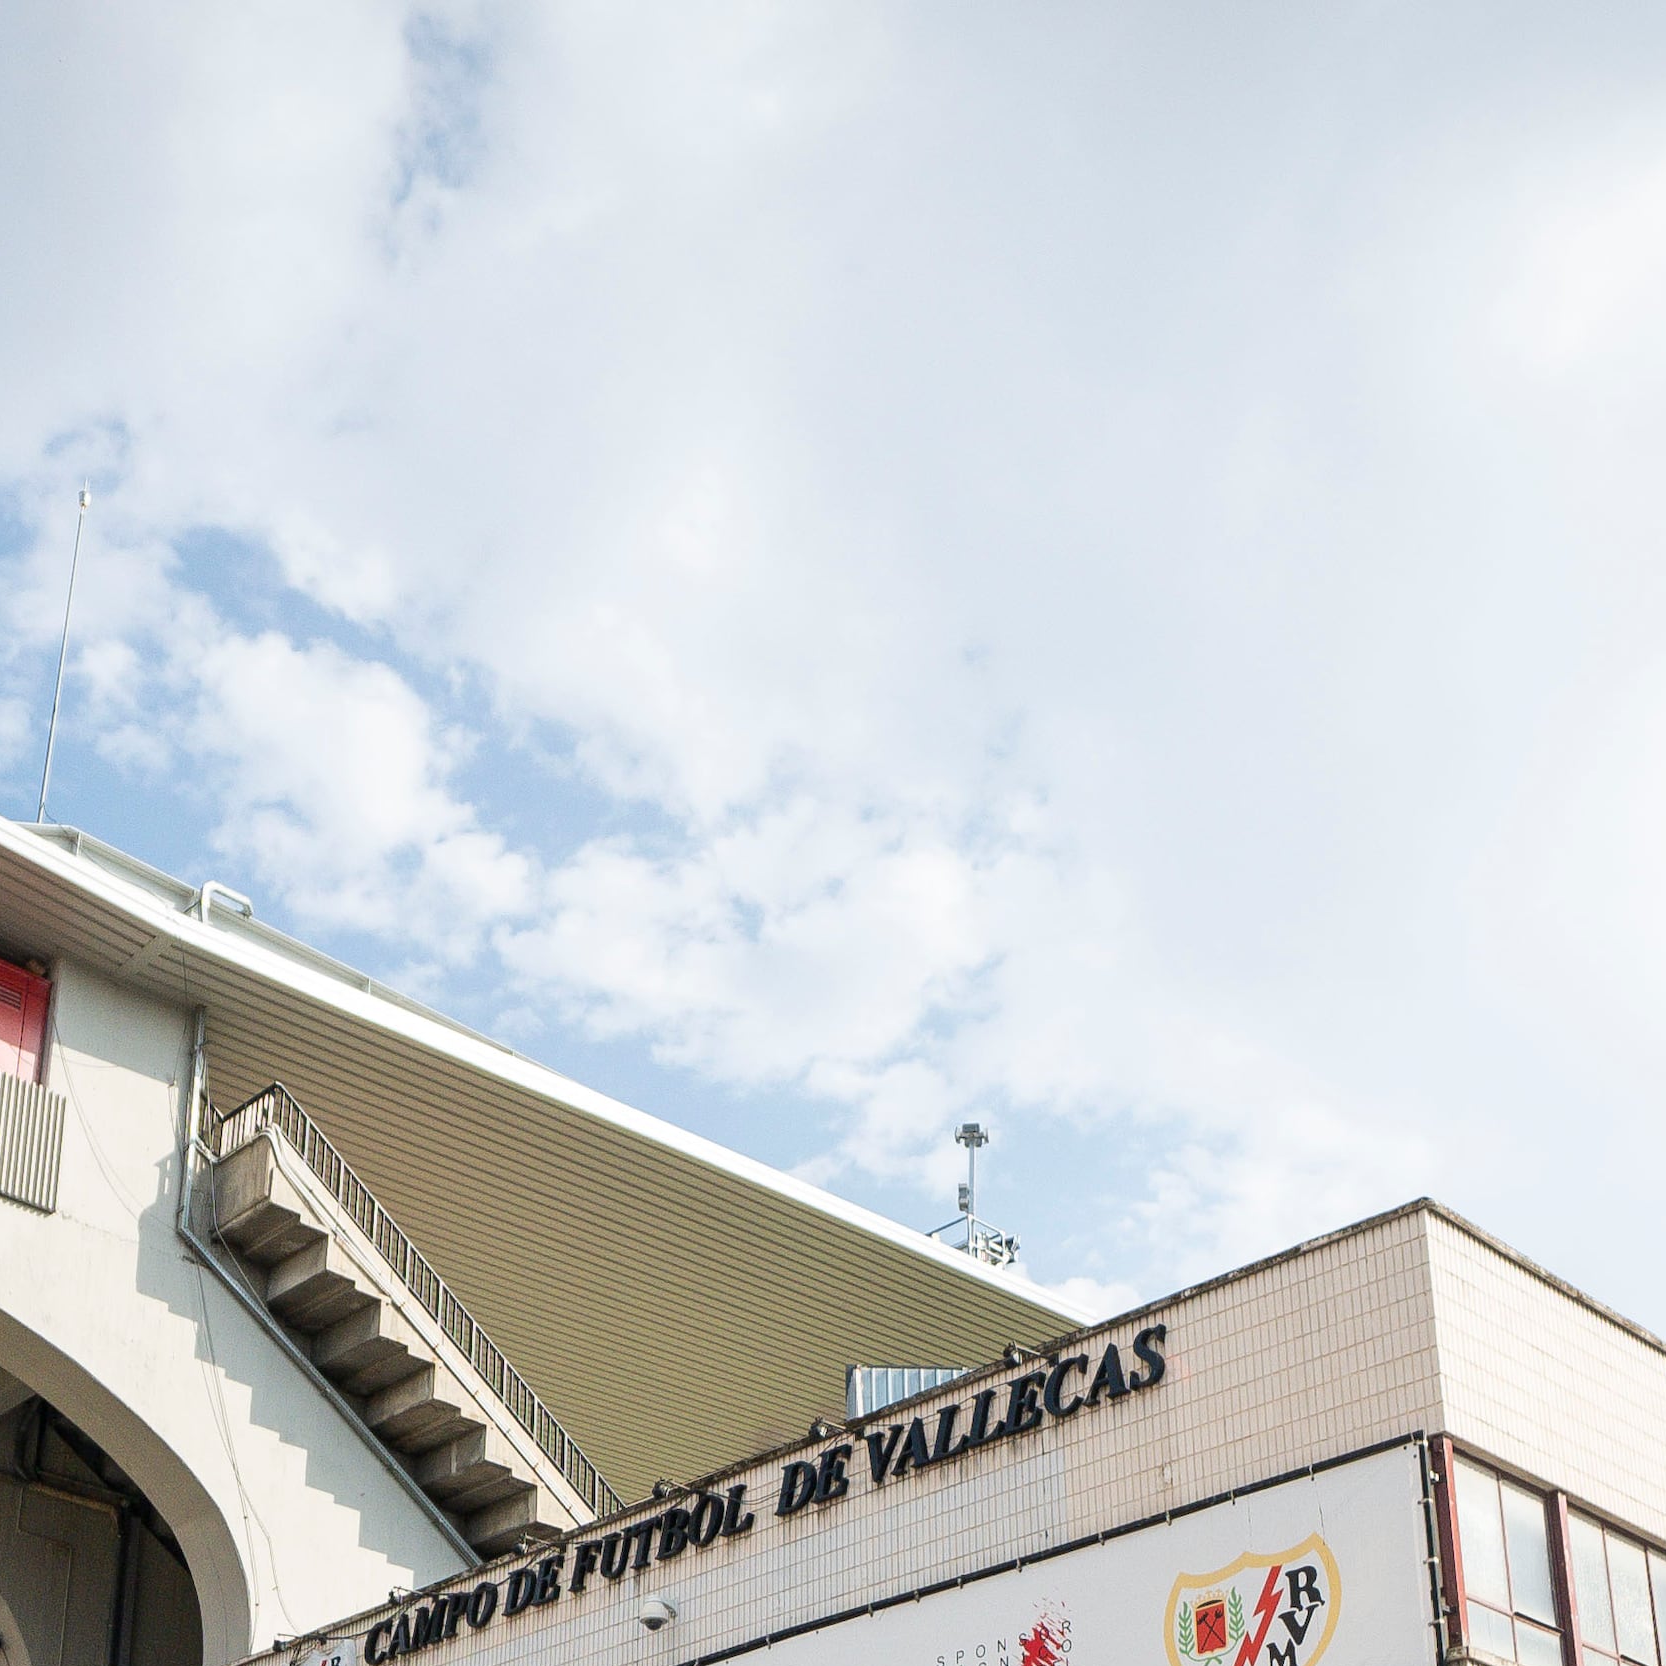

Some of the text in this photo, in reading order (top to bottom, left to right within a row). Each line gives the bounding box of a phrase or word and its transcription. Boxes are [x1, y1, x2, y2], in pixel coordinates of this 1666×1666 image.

[364, 1322, 1167, 1665] CAMPO DE FUTBOL DE VALLECAS
